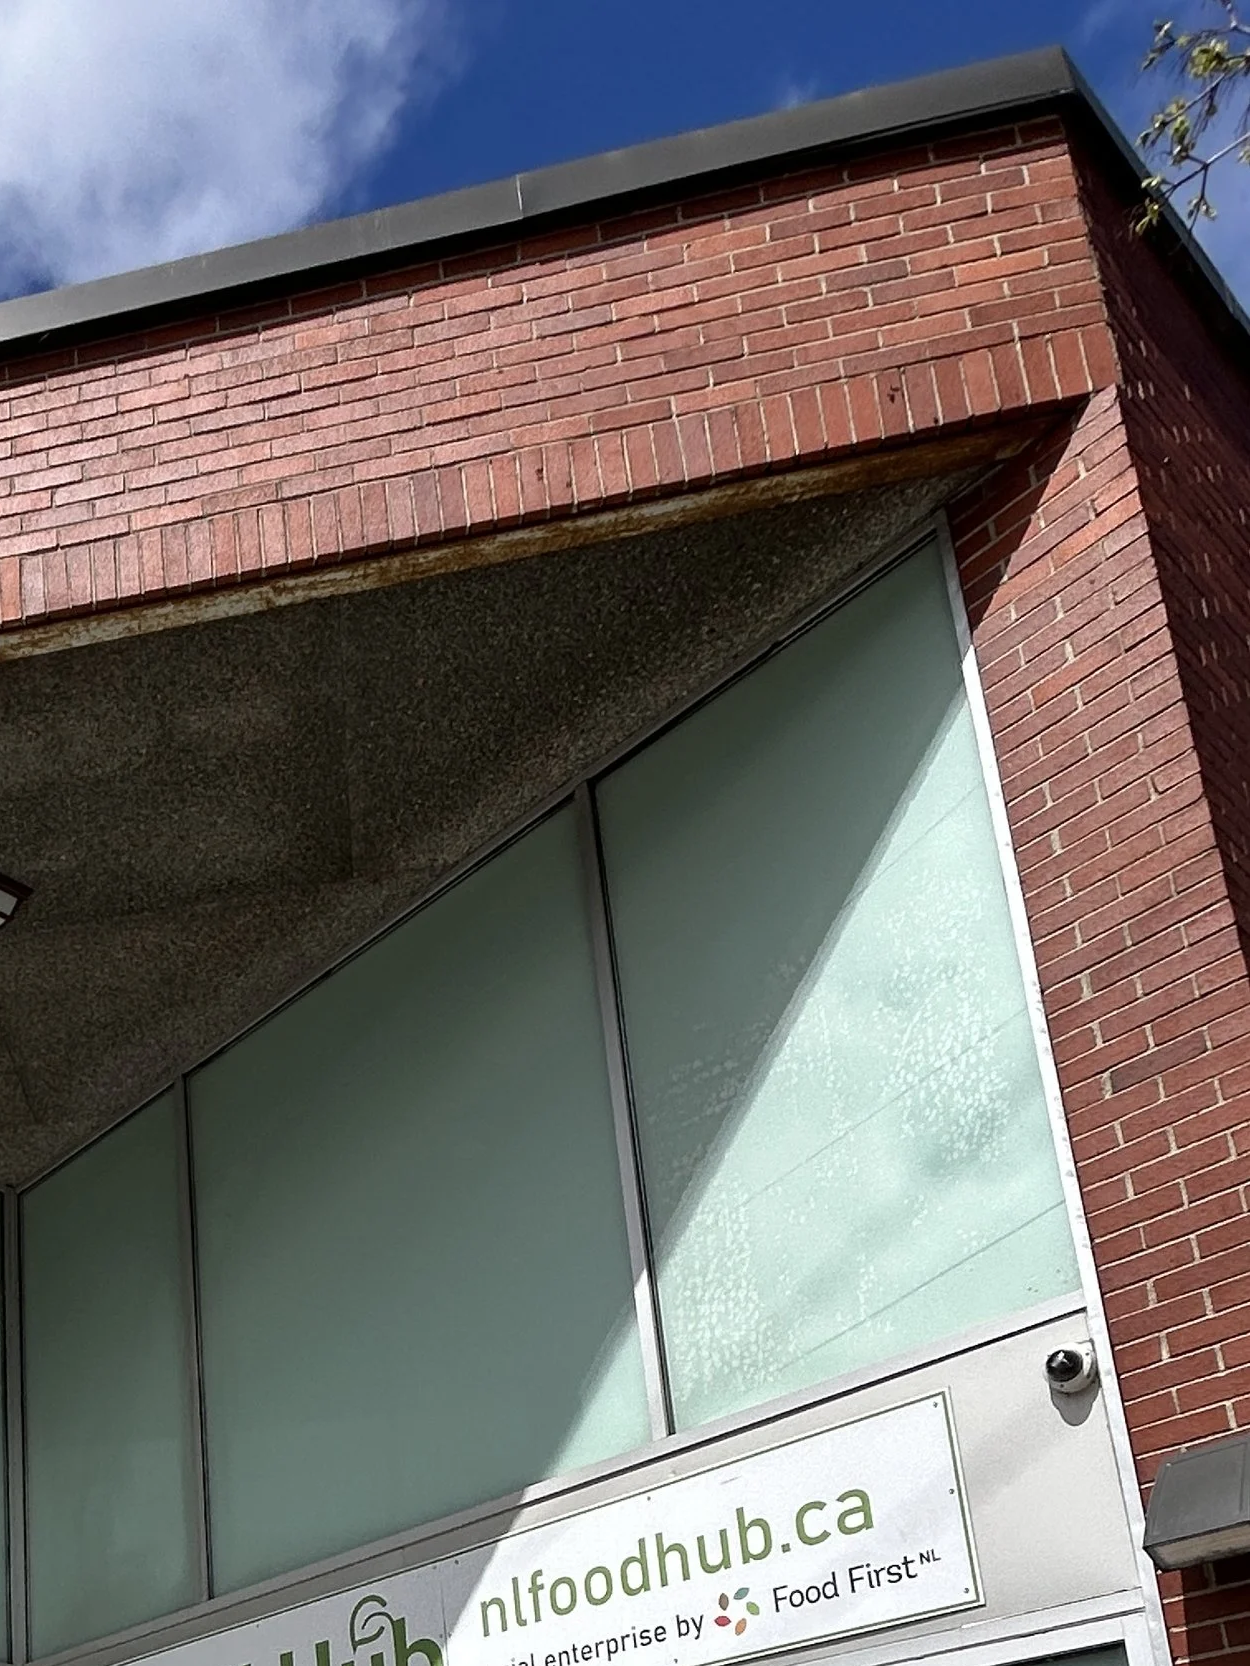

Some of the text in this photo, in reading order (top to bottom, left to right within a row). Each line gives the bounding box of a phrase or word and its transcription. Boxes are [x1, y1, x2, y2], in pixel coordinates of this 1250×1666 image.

[479, 1487, 876, 1638] nlfoodhub.ca
[676, 1613, 705, 1651] by
[772, 1571, 840, 1613] Food
